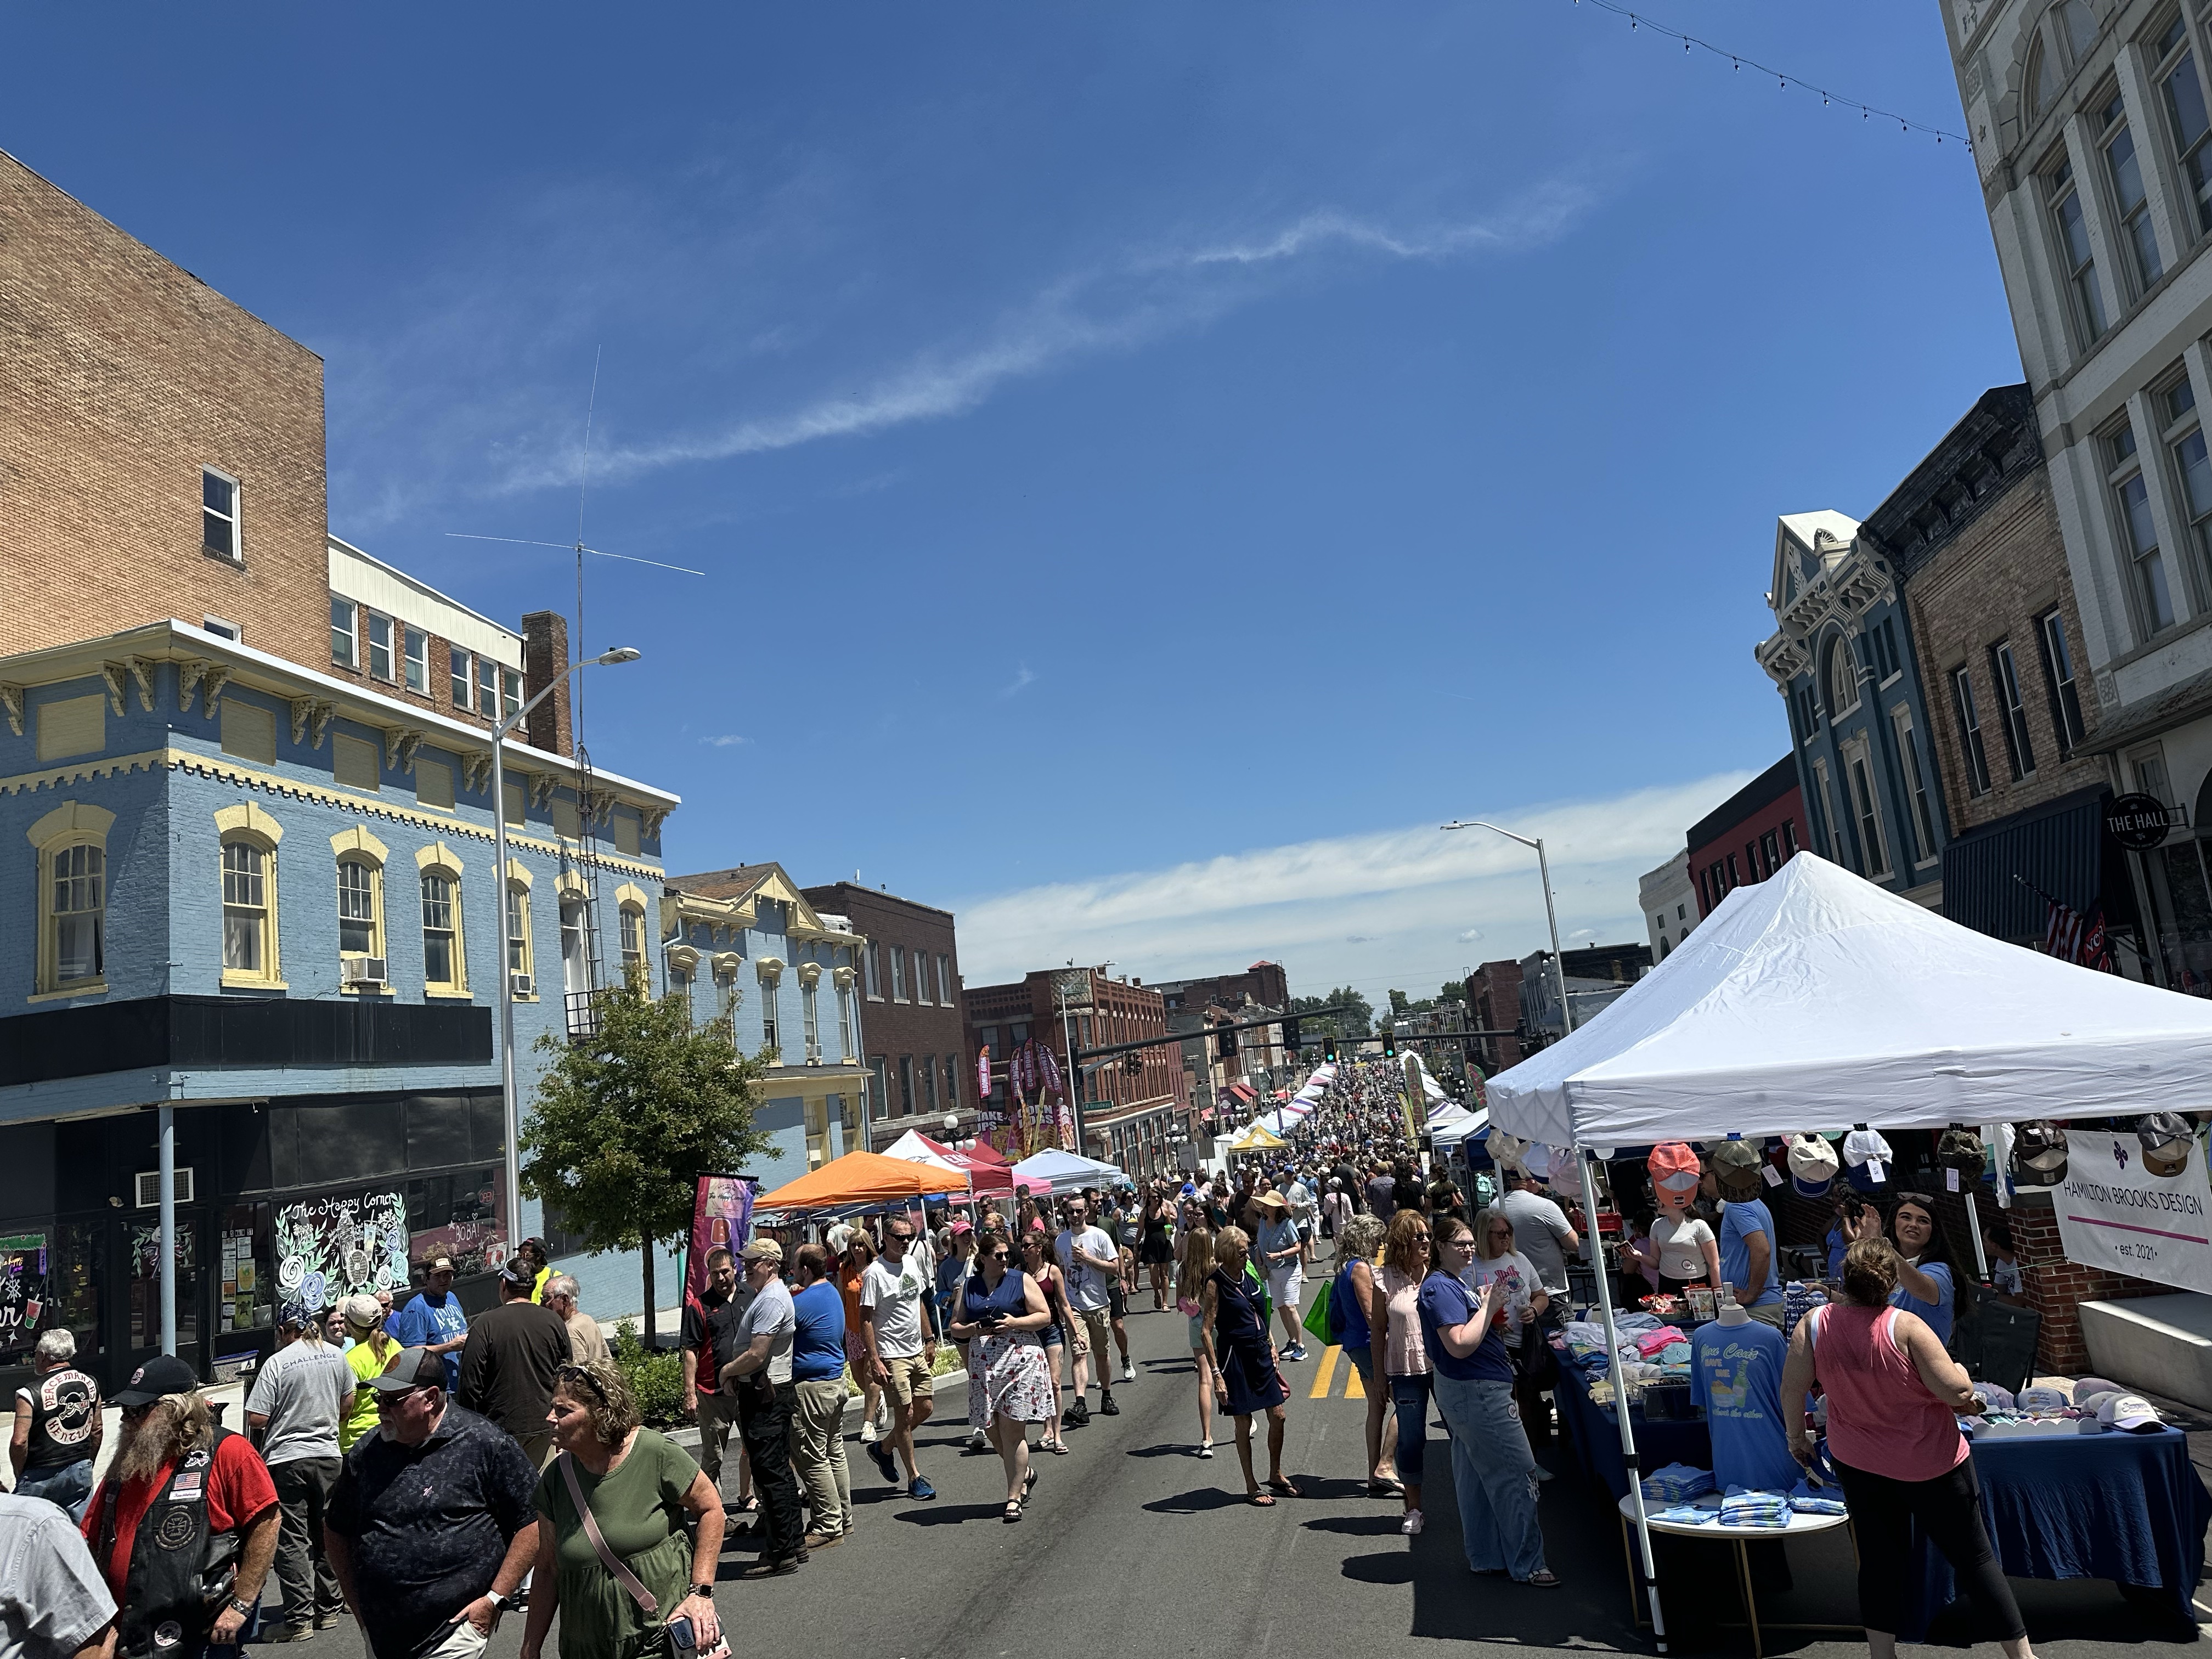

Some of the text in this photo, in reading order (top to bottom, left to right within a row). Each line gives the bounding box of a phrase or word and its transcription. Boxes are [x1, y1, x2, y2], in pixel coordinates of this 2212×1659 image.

[2107, 811, 2168, 833] THE HALL
[1024, 1050, 1033, 1070] DOGS
[292, 1192, 393, 1219] The Happy Corner
[2063, 1180, 2203, 1216] HAMILTON BROOKS DESIGN
[456, 1222, 480, 1243] BOBA!
[2120, 1243, 2154, 1261] est. 2021
[282, 1353, 337, 1370] CHALLENGE
[1701, 1342, 1759, 1362] You Can't
[296, 1360, 328, 1369] TESTING
[1715, 1369, 1730, 1378] ONE
[44, 1372, 96, 1408] PEACEMAKERS
